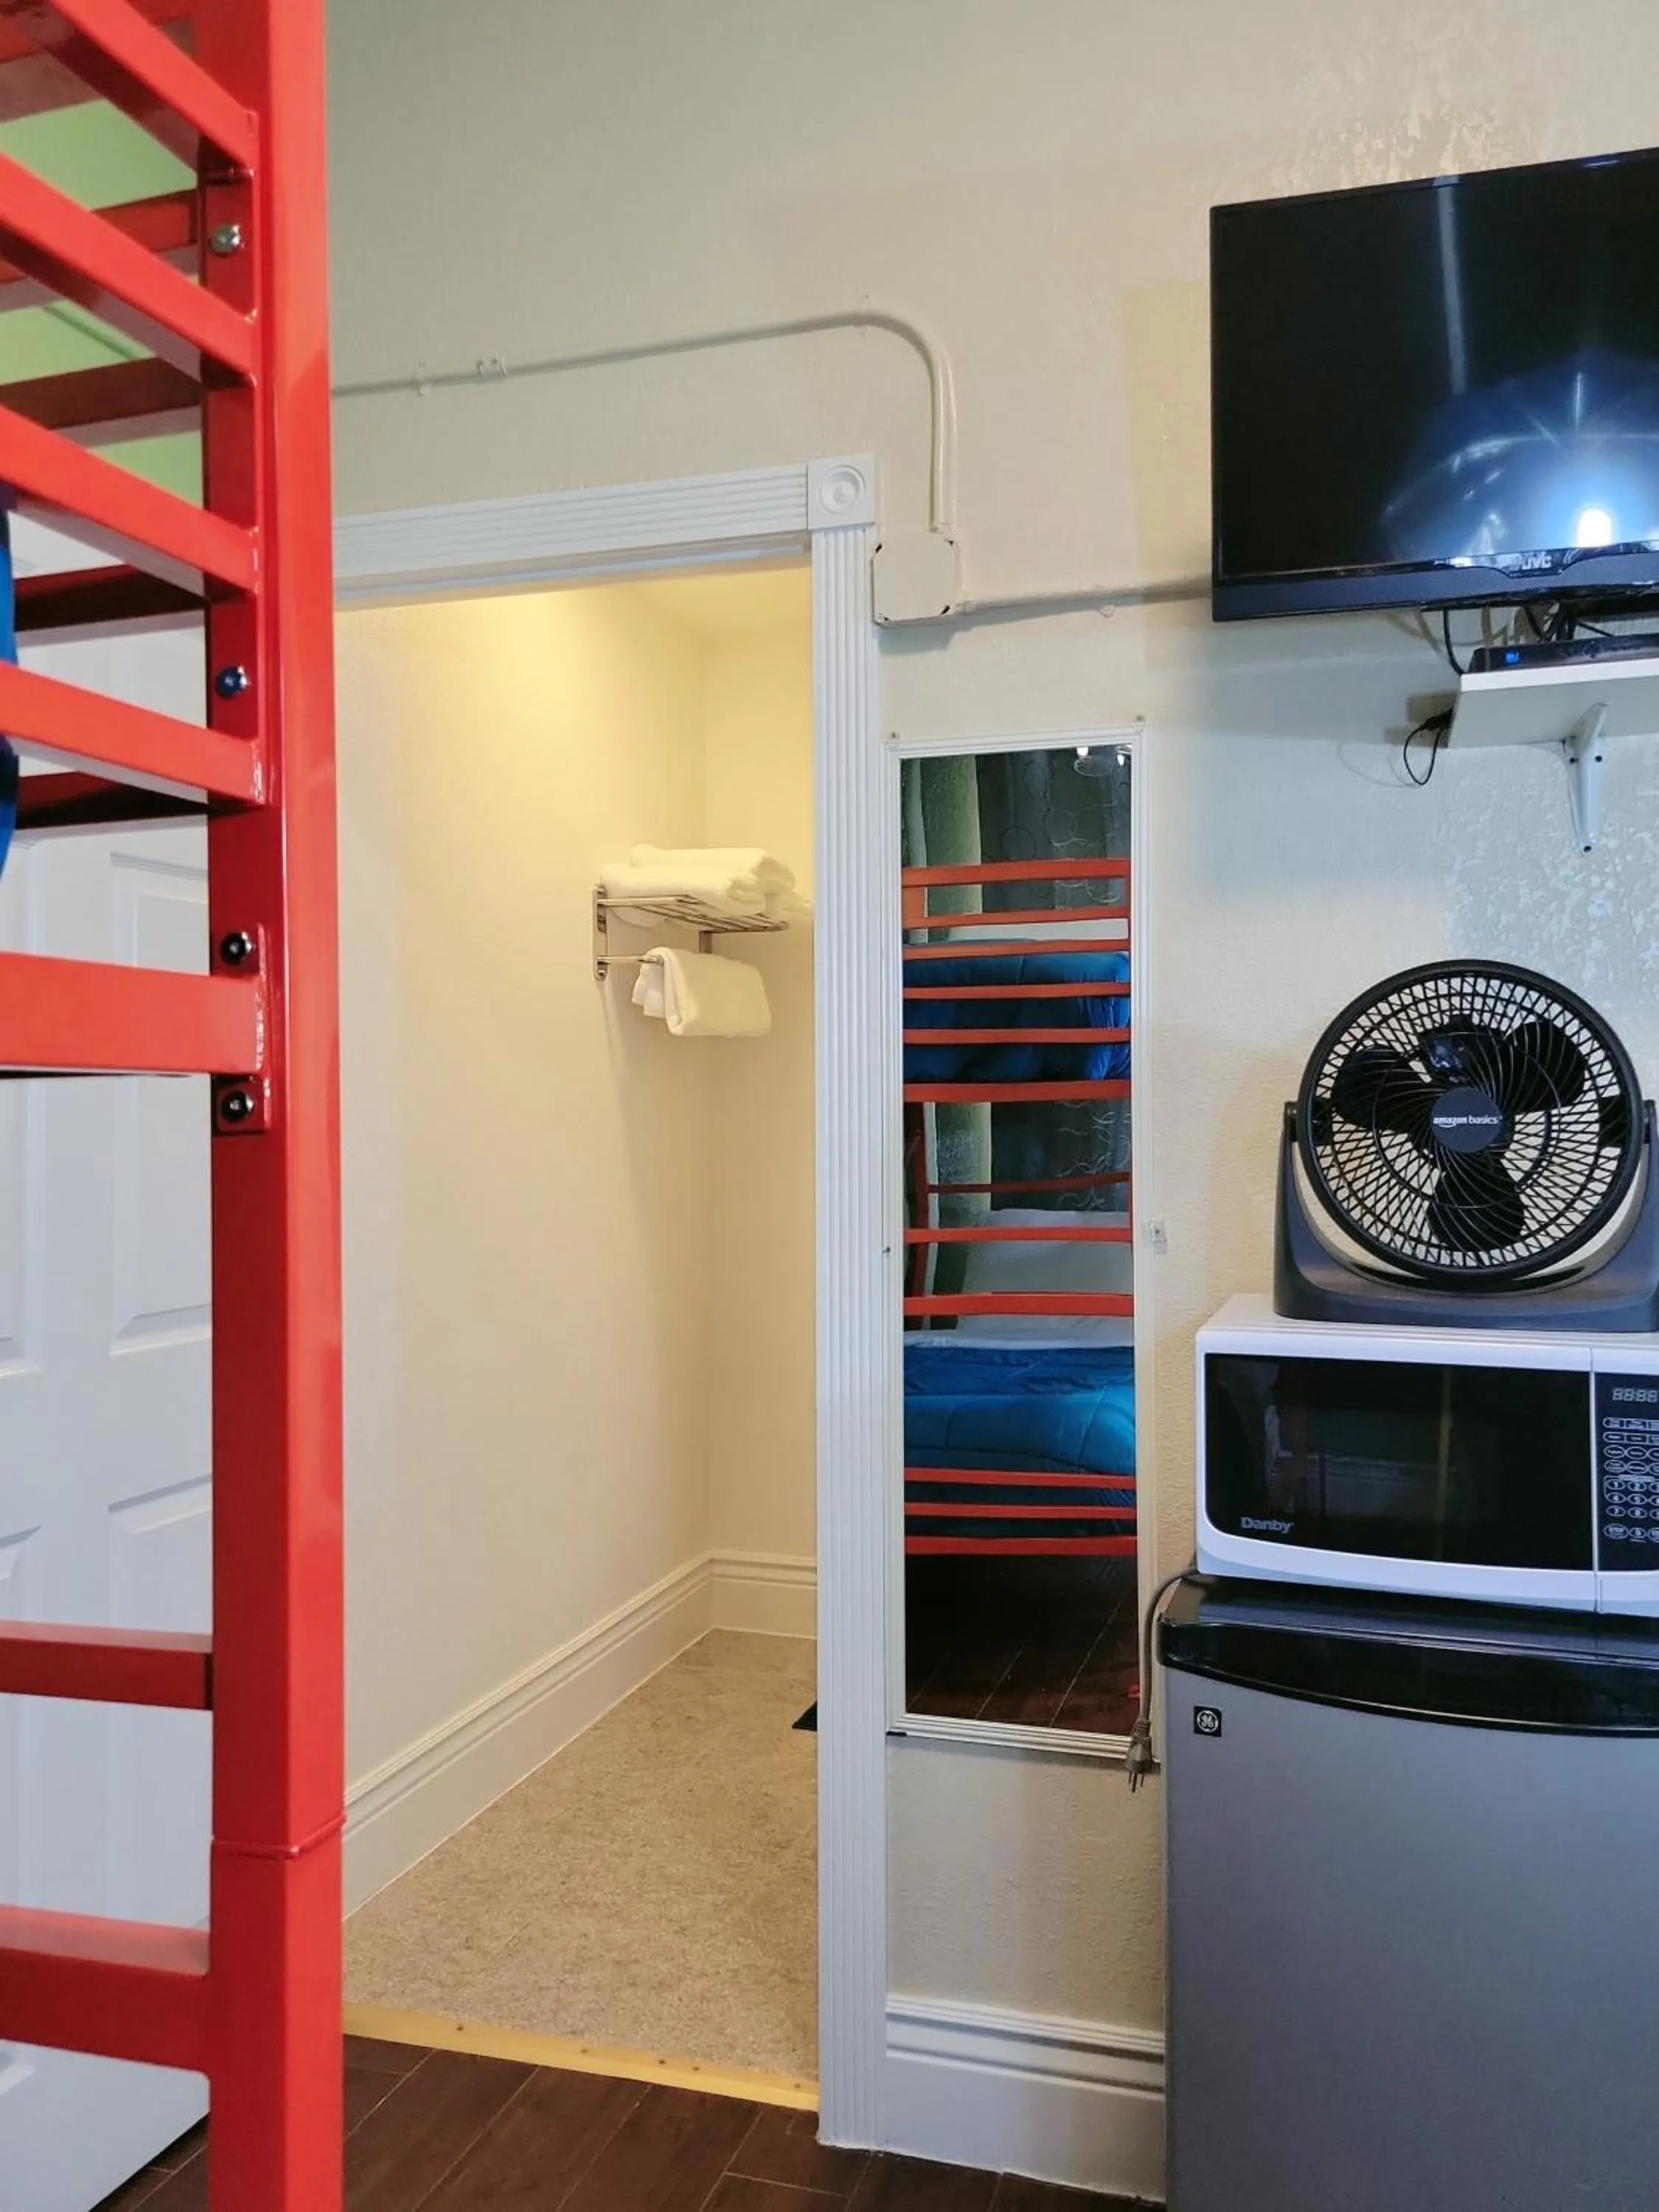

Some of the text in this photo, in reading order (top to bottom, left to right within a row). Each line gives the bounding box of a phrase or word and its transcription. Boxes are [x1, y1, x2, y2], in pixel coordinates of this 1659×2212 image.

[1521, 554, 1551, 569] JVC
[1433, 1115, 1498, 1128] amazon basics
[1241, 1517, 1295, 1534] Danby
